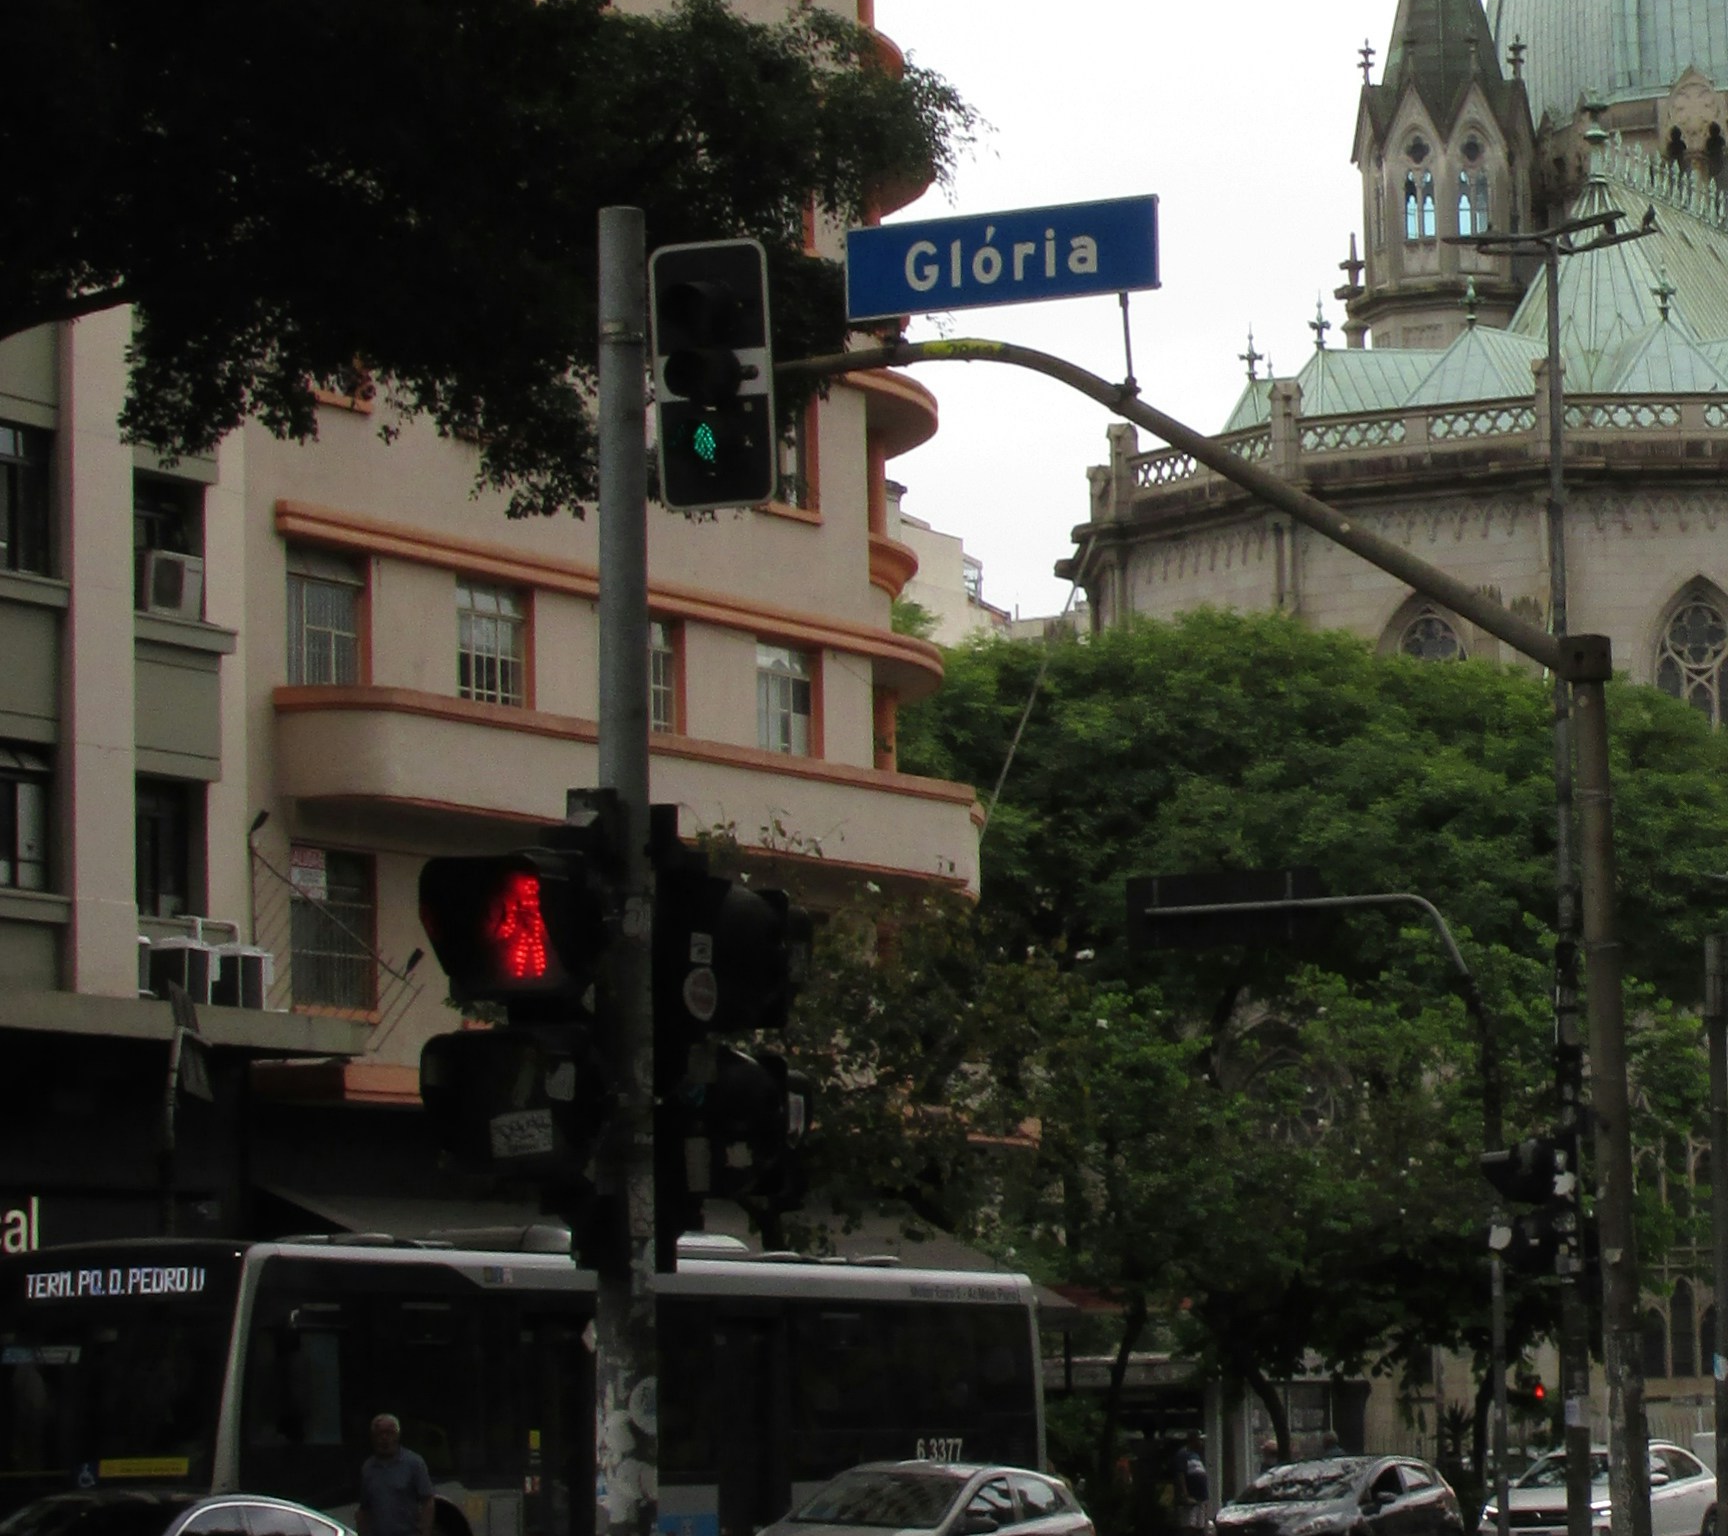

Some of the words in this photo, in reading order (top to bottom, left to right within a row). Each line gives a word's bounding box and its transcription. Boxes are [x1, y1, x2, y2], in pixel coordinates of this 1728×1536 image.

[904, 225, 1098, 292] Glória
[26, 1271, 75, 1299] TERM.
[128, 1267, 187, 1295] PEDRO
[929, 1438, 963, 1463] 3377
